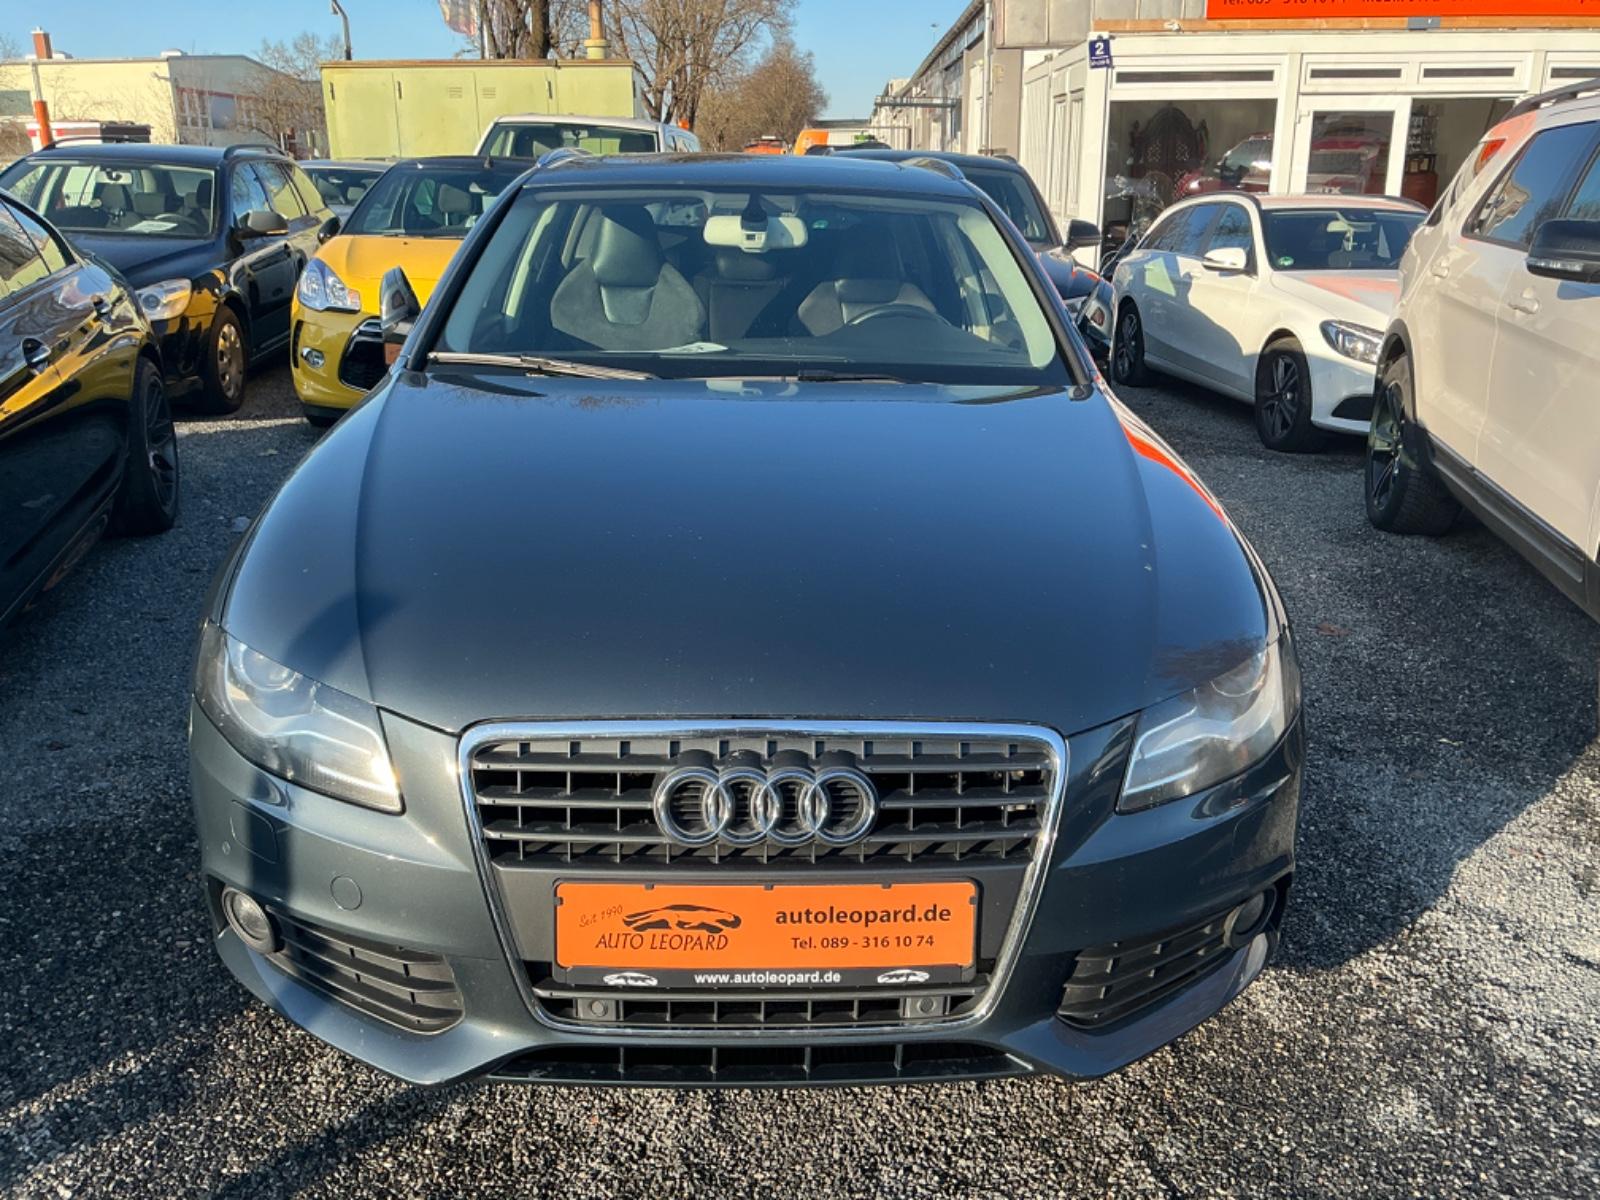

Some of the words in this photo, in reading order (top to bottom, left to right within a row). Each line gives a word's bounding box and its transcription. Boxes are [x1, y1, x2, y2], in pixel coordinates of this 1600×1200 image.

[1095, 42, 1105, 56] 2
[601, 904, 623, 920] 1990
[775, 903, 952, 928] autoleopard.de
[595, 932, 645, 950] AUTO
[650, 933, 729, 952] LEOPARD
[791, 937, 817, 950] Tel.
[820, 936, 849, 949] 089
[861, 935, 890, 949] 316
[895, 935, 912, 948] 10
[916, 934, 935, 948] 74
[694, 970, 842, 986] www.autoleopard.de
